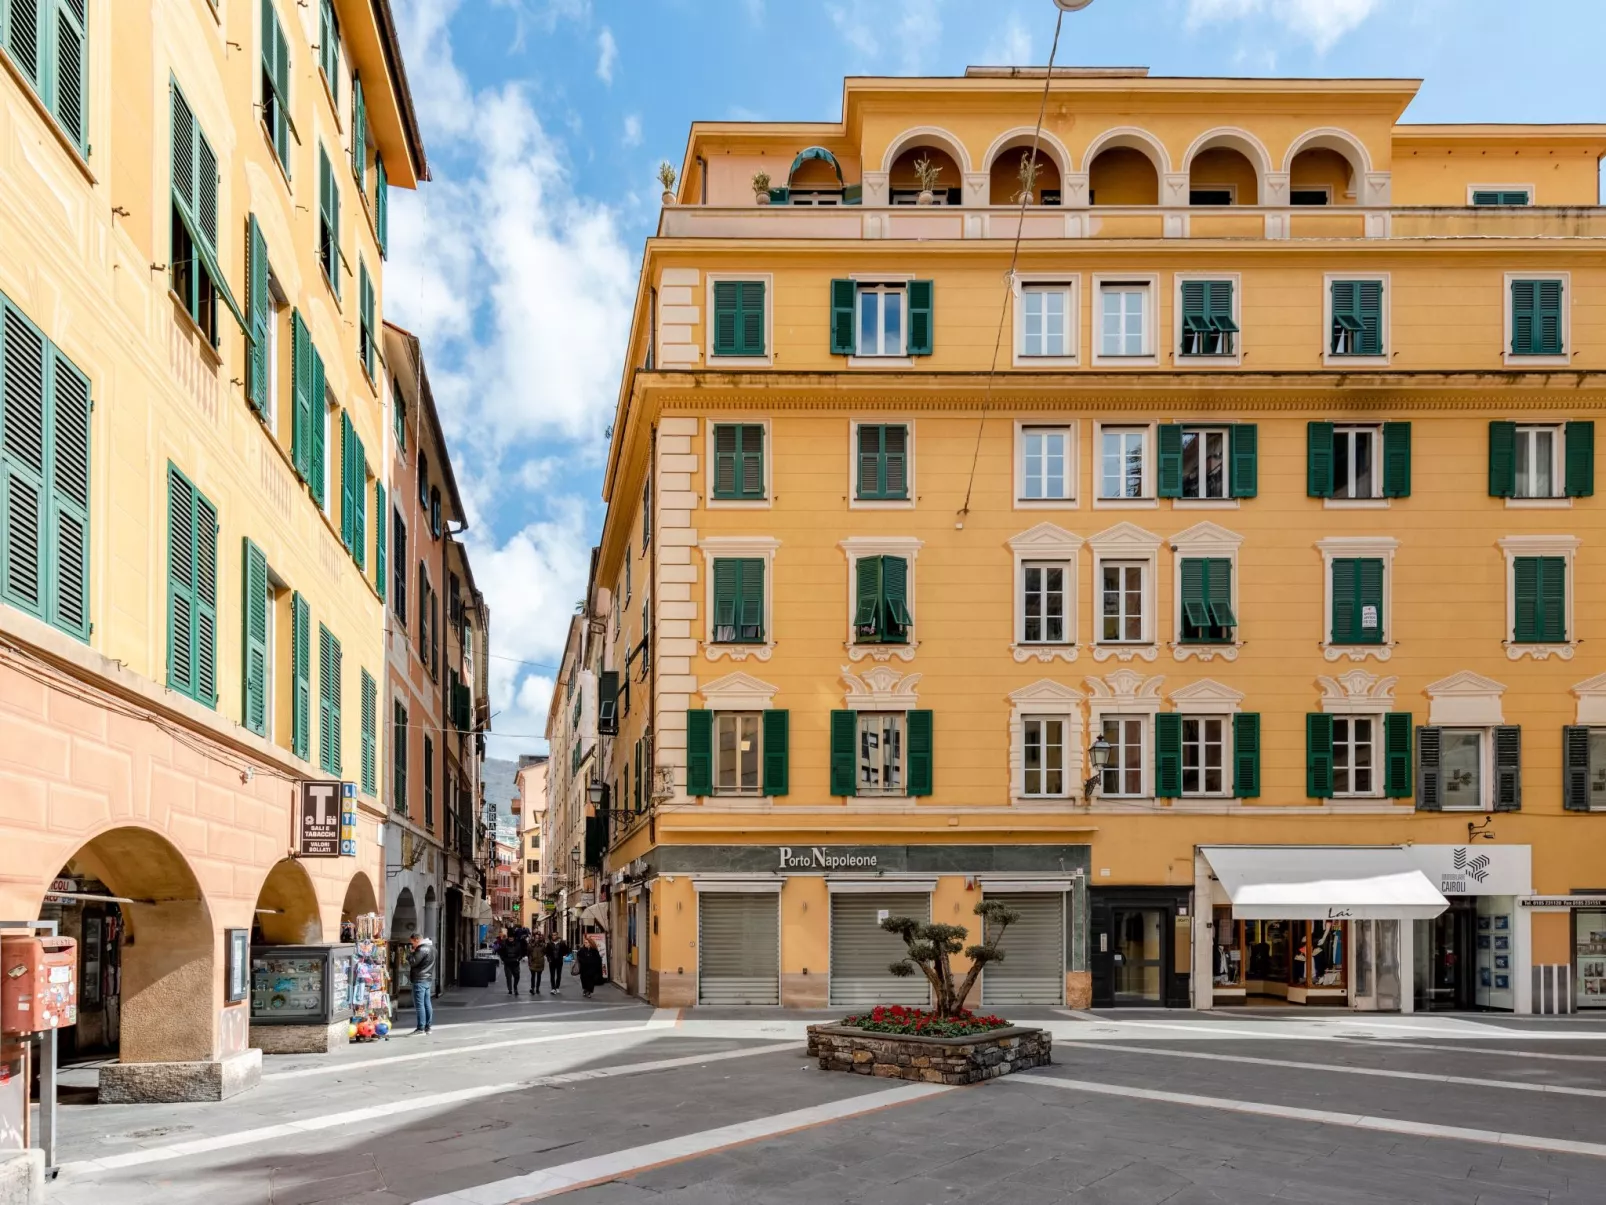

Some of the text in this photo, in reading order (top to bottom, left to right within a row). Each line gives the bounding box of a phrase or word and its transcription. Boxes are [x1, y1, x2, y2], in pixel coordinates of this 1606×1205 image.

[342, 785, 352, 853] LOTTO
[779, 847, 878, 869] Porto Napoleone
[1441, 881, 1466, 893] CAIROLI
[1328, 907, 1353, 919] Lai
